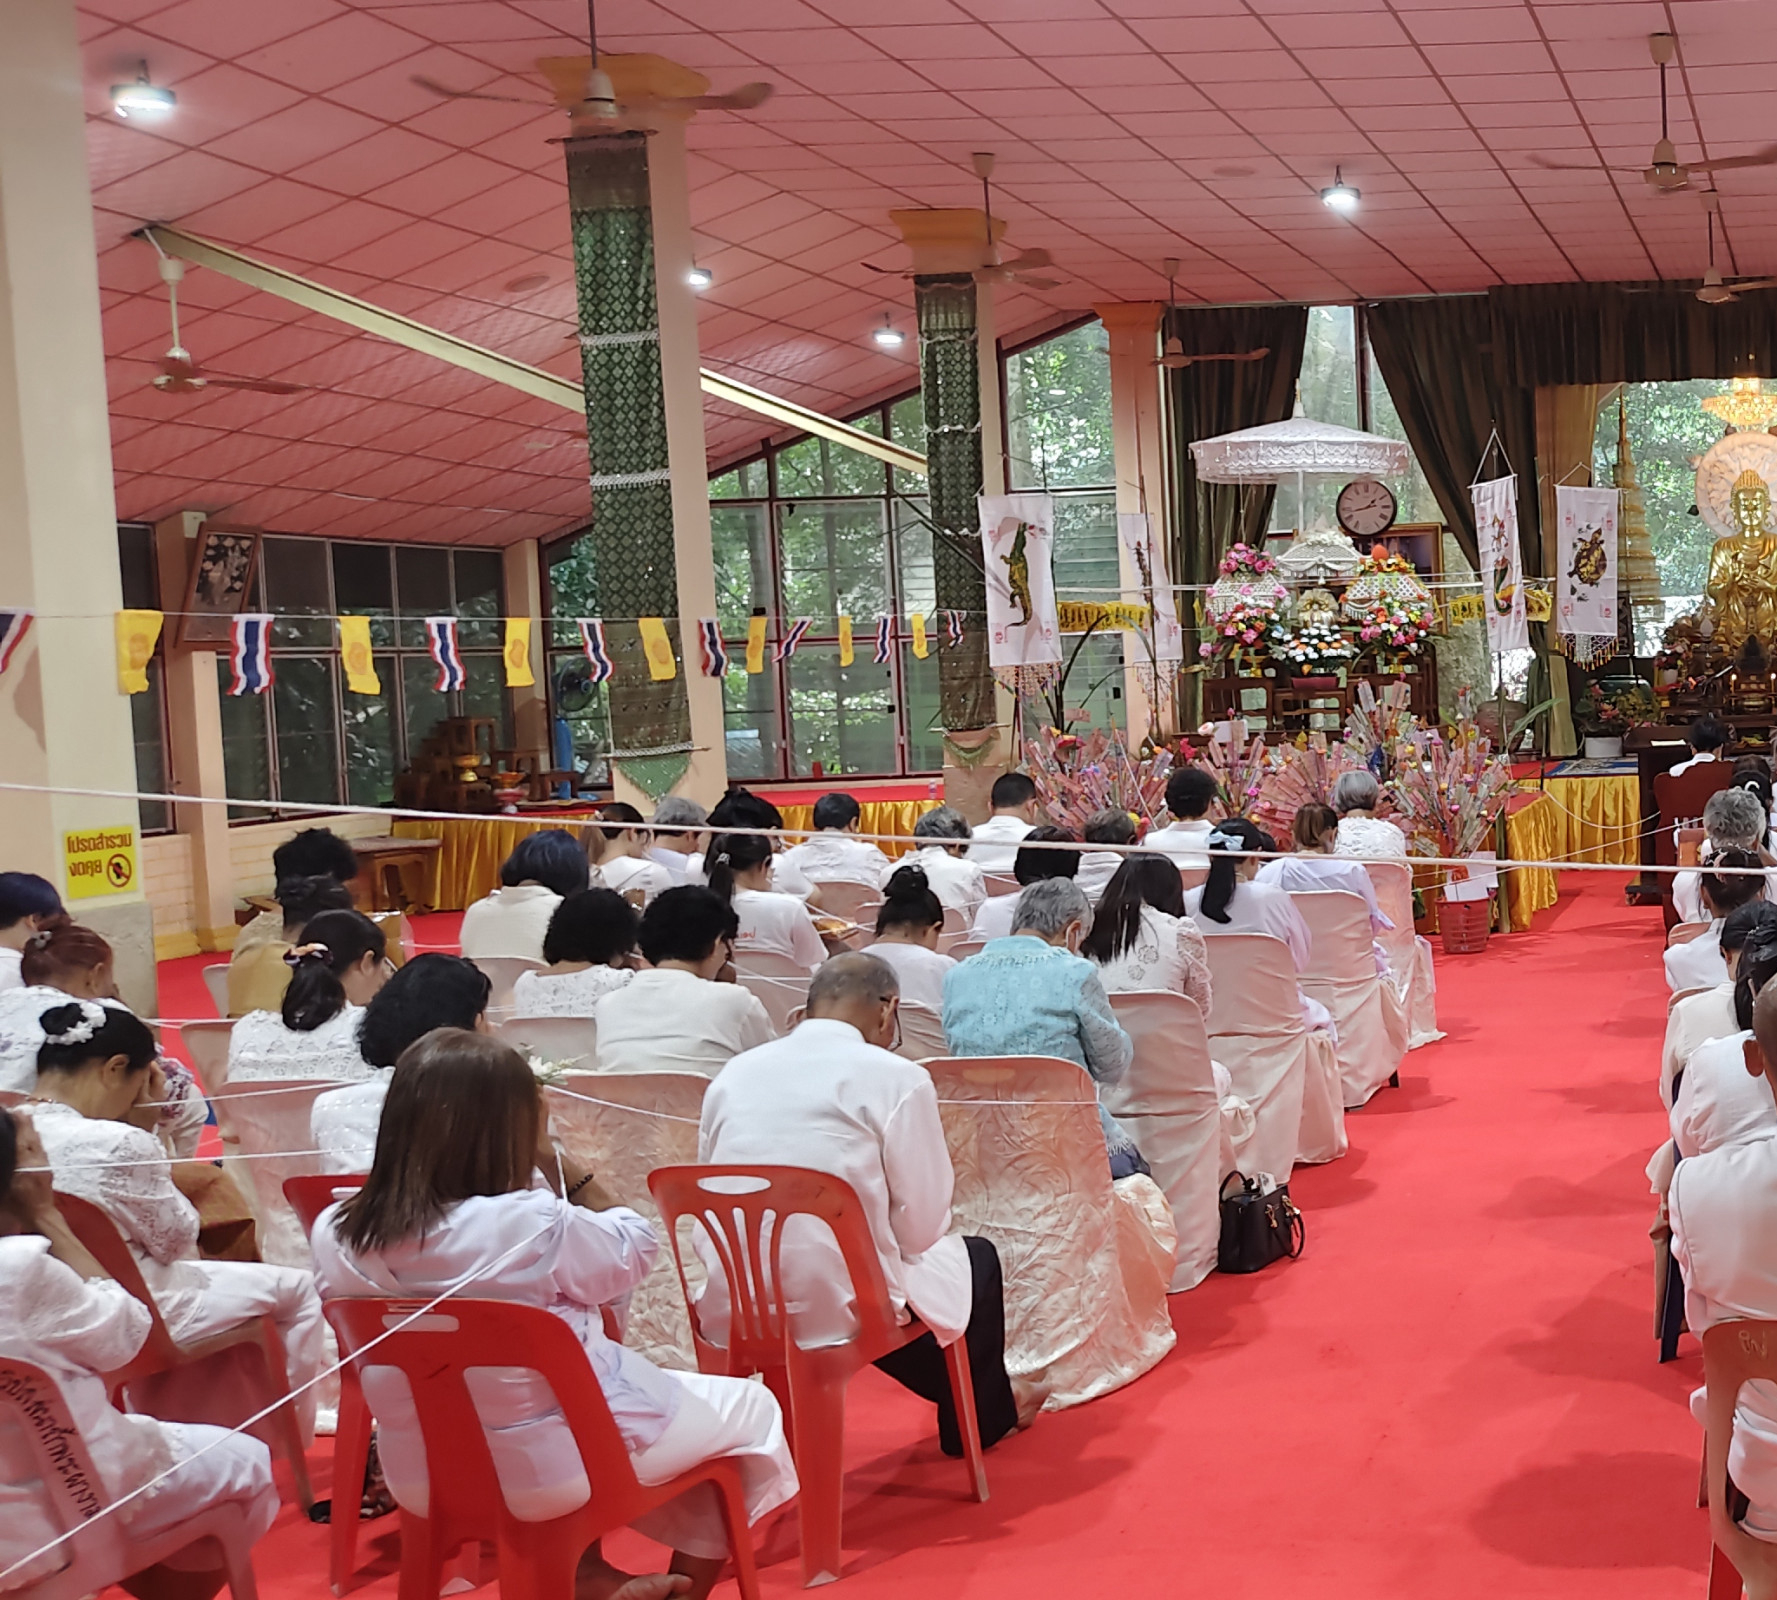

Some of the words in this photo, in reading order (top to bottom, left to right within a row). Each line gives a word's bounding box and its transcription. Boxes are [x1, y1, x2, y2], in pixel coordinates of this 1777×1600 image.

[67, 833, 132, 854] โปรดสำรวม
[69, 859, 103, 878] งดคุย
